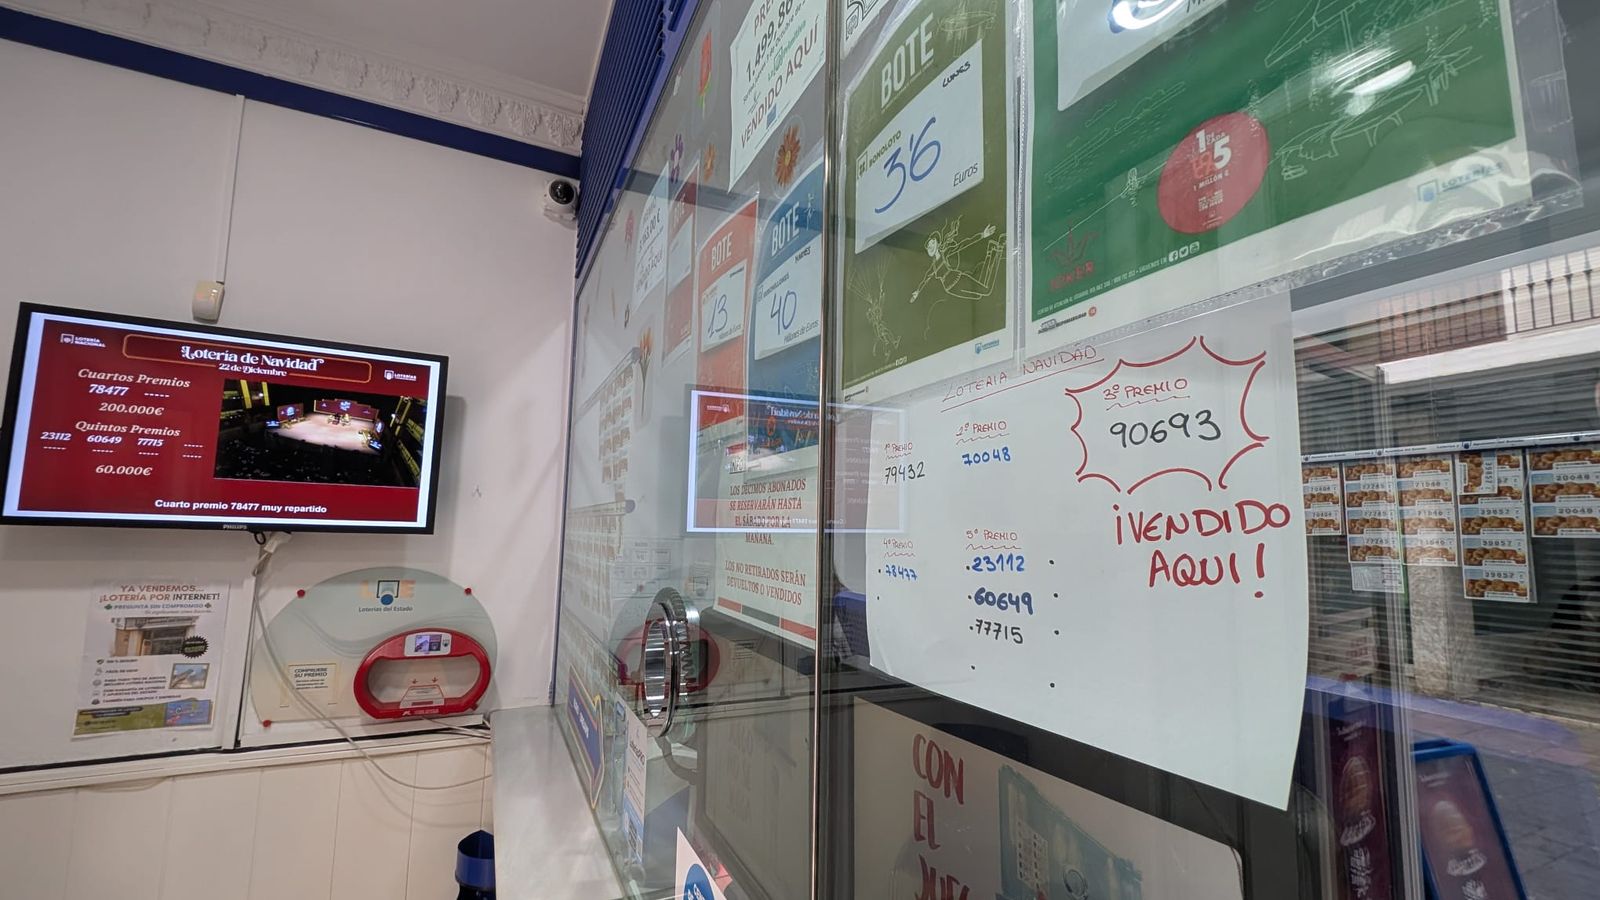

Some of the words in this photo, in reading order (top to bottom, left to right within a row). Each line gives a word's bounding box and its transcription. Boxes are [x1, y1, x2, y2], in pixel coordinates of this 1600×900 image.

[881, 12, 934, 110] BOTE
[741, 75, 783, 149] VENDIDO
[785, 14, 819, 84] AQUÍ
[868, 130, 902, 168] BONOLOTO
[1196, 129, 1206, 153] 1
[1214, 135, 1232, 169] 5
[953, 163, 978, 187] Euros
[772, 201, 799, 256] BOTE
[711, 232, 733, 272] BOTE
[770, 290, 797, 336] 40
[181, 345, 238, 364] Lotería
[240, 353, 259, 365] de
[260, 355, 324, 371] Navidad
[78, 369, 134, 382] Cuartos
[136, 374, 191, 388] Premios
[219, 363, 230, 371] 22
[230, 364, 242, 372] de
[242, 365, 287, 377] Diciembre
[88, 384, 129, 396] 78477
[943, 372, 1007, 402] LOTERIA
[1103, 384, 1120, 400] 3º
[1124, 378, 1188, 399] PREMIO
[99, 402, 165, 416] 200.000€
[40, 431, 72, 441] 23112
[87, 434, 122, 444] 60649
[137, 438, 163, 447] 77715
[75, 420, 127, 433] Quintos
[130, 425, 180, 437] Premios
[955, 422, 970, 436] 2º
[972, 421, 1007, 433] PREMIO
[1110, 409, 1221, 448] 90693
[961, 446, 1011, 466] 70048
[95, 464, 152, 476] 60.000€
[885, 461, 925, 484] 79432
[730, 485, 739, 496] LOS
[768, 479, 806, 493] ABONADOS
[154, 499, 190, 509] Cuarto
[192, 502, 228, 511] premio
[231, 502, 259, 511] 78477
[261, 504, 283, 514] muy
[284, 505, 327, 513] repartido
[729, 501, 736, 511] SE
[737, 496, 775, 510] RESERVARÁN
[777, 497, 801, 510] HASTA
[735, 516, 742, 526] EL
[984, 530, 1018, 541] PREMIO
[725, 560, 735, 572] LOS
[736, 563, 744, 574] NO
[745, 564, 779, 581] RETIRADOS
[780, 570, 806, 587] SERÁN
[885, 564, 918, 581] 78477
[971, 553, 1025, 572] 23112
[121, 585, 135, 593] YA
[172, 592, 220, 601] INTERNET!
[727, 576, 759, 594] DEVUELTOS
[766, 585, 802, 606] VENDIDOS
[974, 587, 1033, 615] 60649
[975, 619, 1023, 644] 77715
[913, 733, 964, 805] CON
[914, 790, 941, 850] EL
